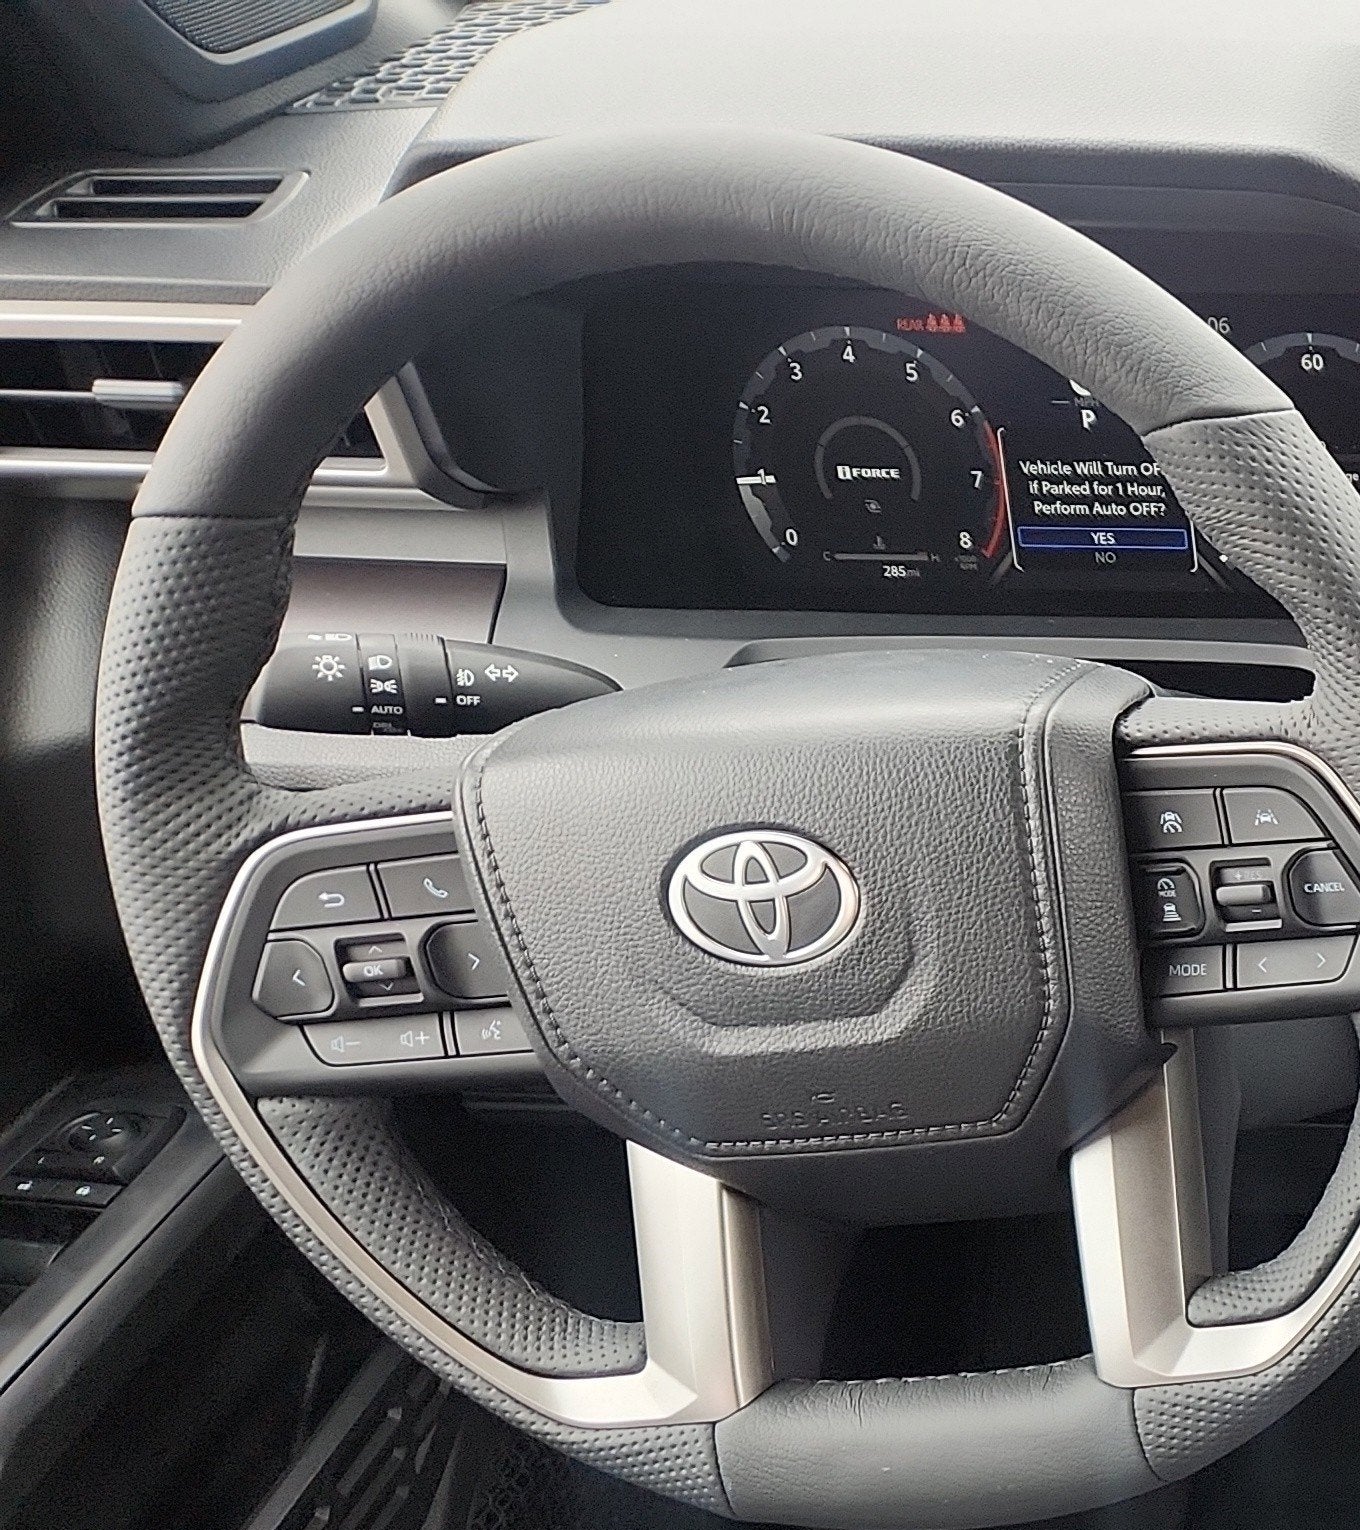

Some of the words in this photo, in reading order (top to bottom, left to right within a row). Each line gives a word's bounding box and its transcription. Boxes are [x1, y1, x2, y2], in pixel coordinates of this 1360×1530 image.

[1207, 316, 1231, 334] 06
[842, 345, 856, 363] 4
[1300, 353, 1324, 371] 60
[789, 362, 803, 381] 3
[905, 362, 919, 382] 5
[757, 405, 771, 424] 2
[950, 409, 965, 427] 6
[1081, 409, 1097, 431] P
[1019, 460, 1072, 476] Vehicle
[1073, 461, 1102, 476] Will
[1105, 461, 1138, 475] Turn
[1140, 462, 1162, 476] OF
[970, 470, 983, 489] 7
[1028, 480, 1039, 494] if
[1042, 480, 1090, 495] Parked
[1094, 481, 1113, 495] for
[1116, 484, 1124, 496] 1
[1127, 483, 1167, 498] Hour,
[1034, 501, 1090, 515] Perform
[1092, 502, 1127, 515] Auto
[1129, 502, 1167, 517] OFF?
[785, 528, 799, 546] 0
[959, 531, 972, 549] 8
[1090, 532, 1116, 545] YES
[1094, 552, 1117, 564] NO
[370, 704, 404, 715] AUTO
[456, 695, 481, 706] OFF
[1304, 881, 1345, 893] CANCEL
[363, 963, 384, 977] OK
[1168, 963, 1208, 976] MODE
